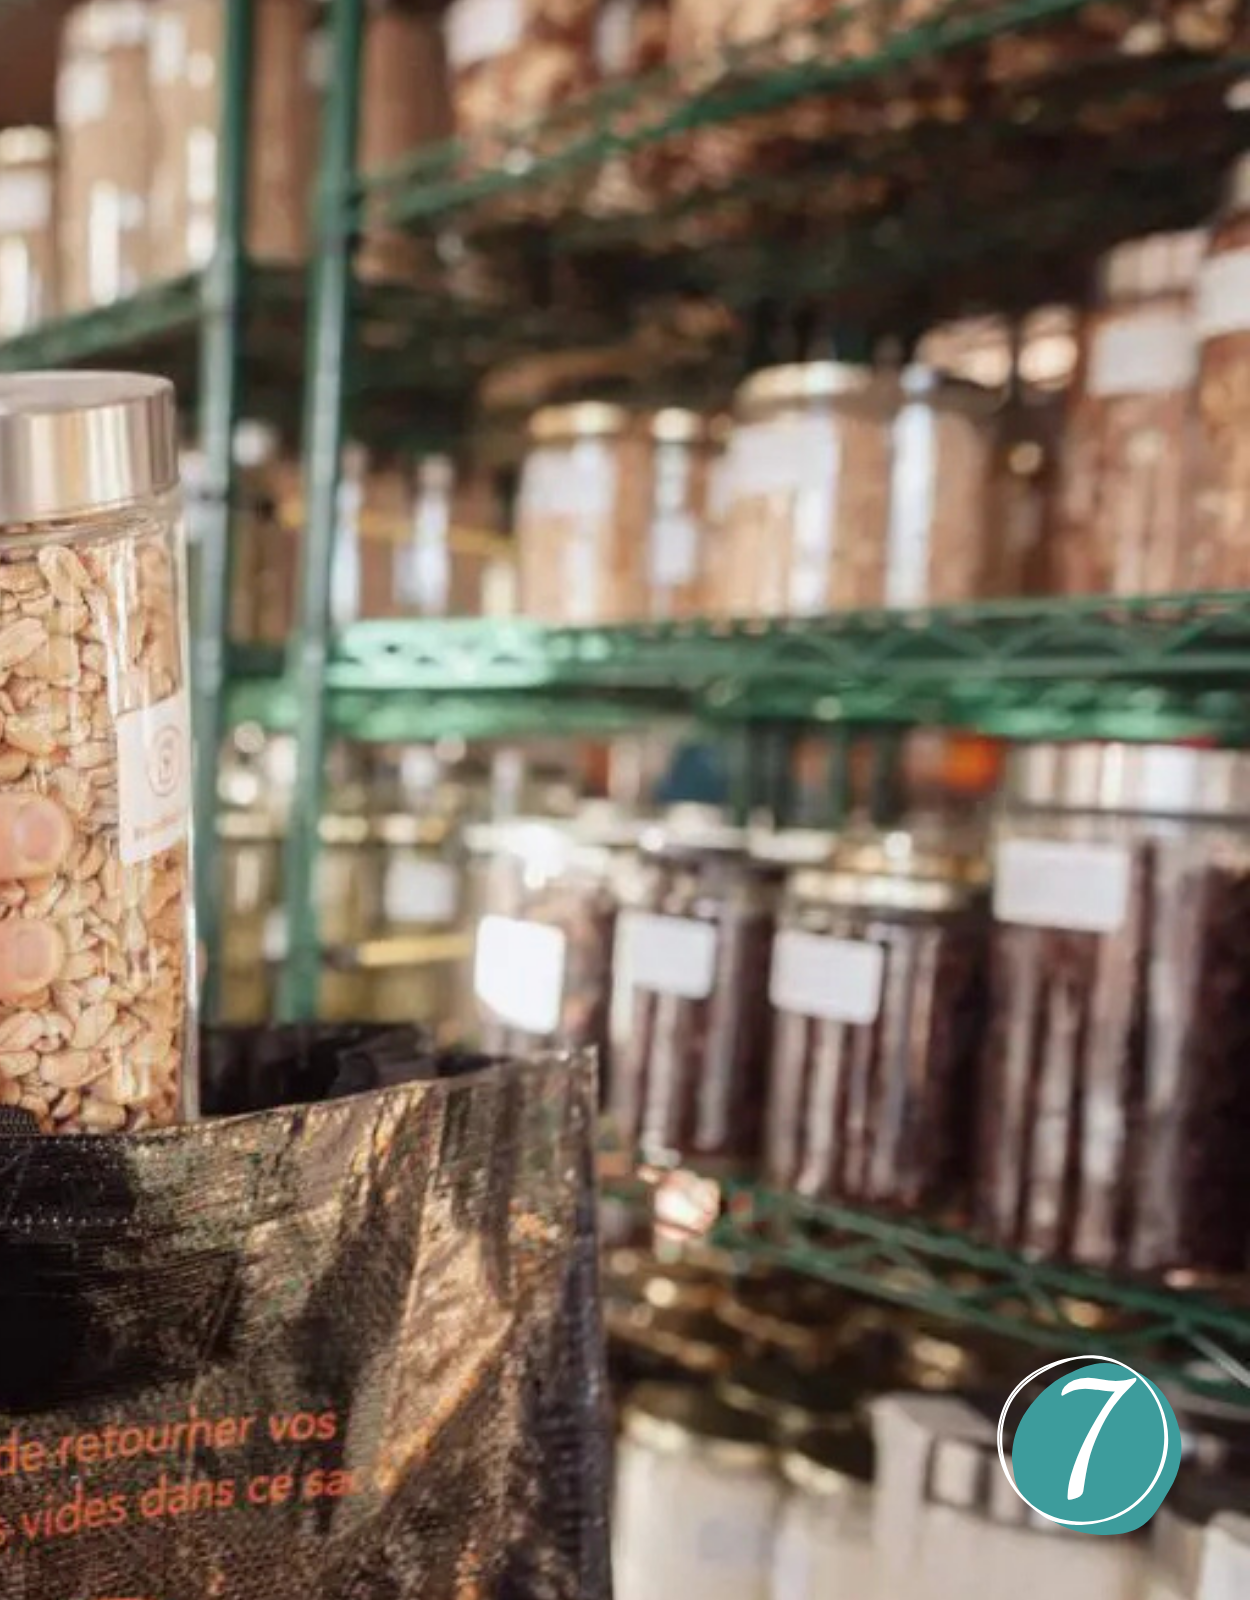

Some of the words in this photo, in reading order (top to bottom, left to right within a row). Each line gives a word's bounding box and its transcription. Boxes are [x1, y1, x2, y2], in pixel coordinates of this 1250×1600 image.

[55, 1412, 254, 1467] retourner
[268, 1409, 337, 1442] vos
[20, 1482, 127, 1539] vides
[139, 1473, 236, 1518] dans
[247, 1472, 294, 1504] ce
[303, 1468, 364, 1498] sa
